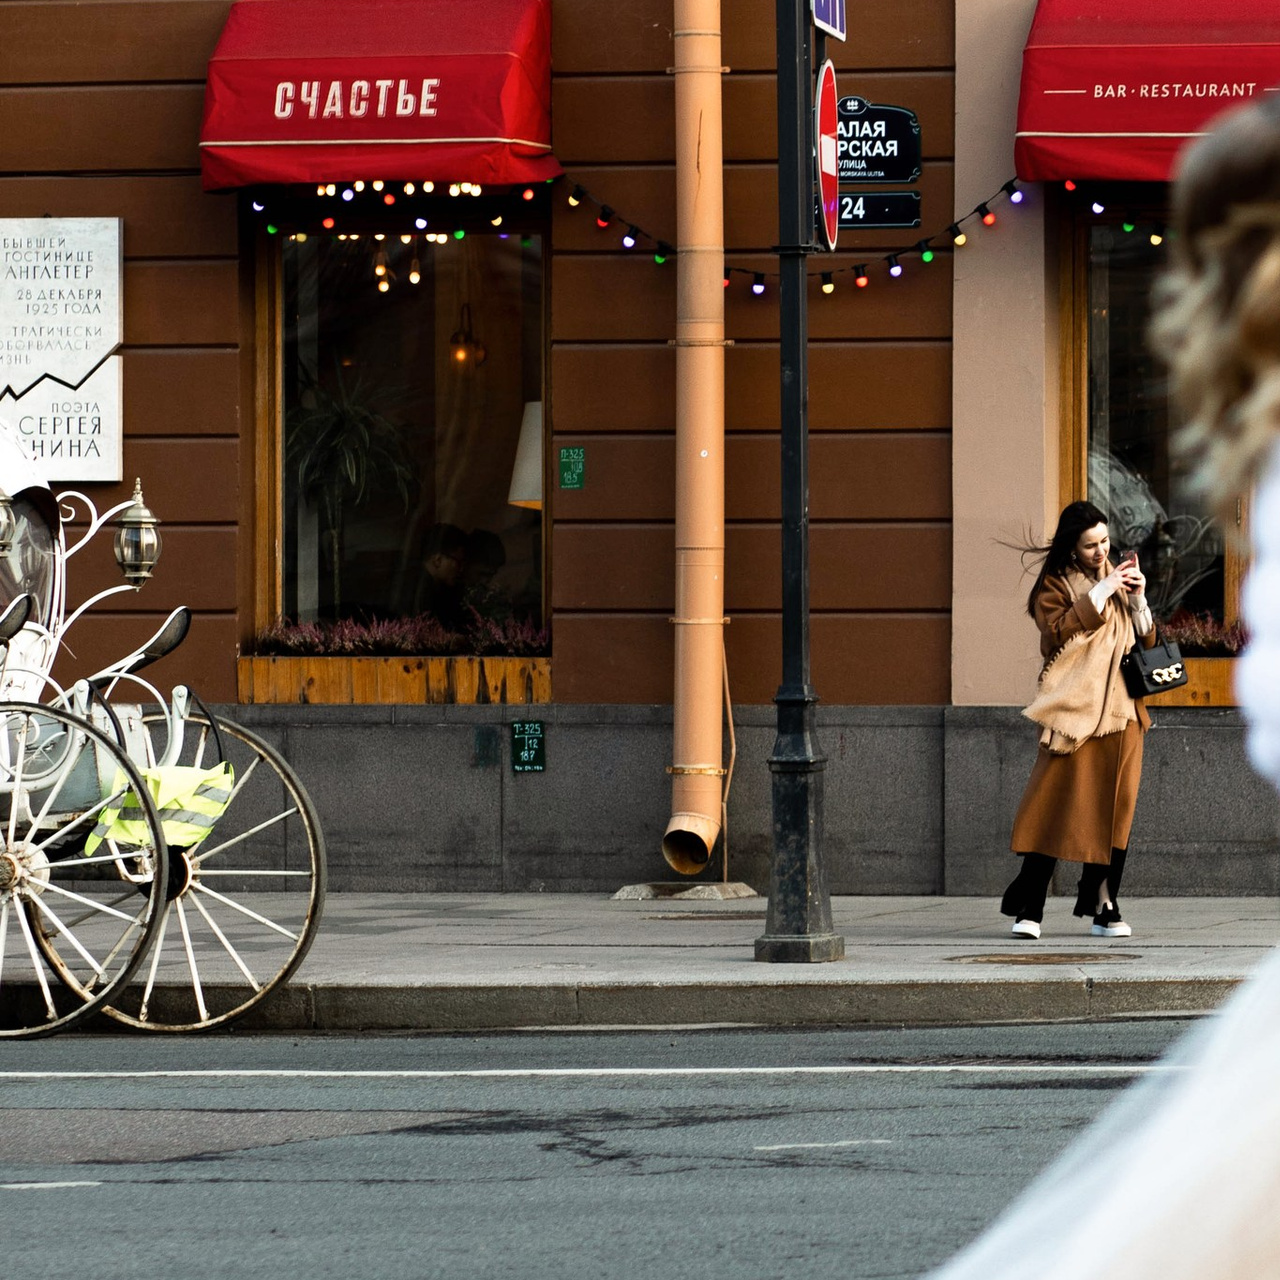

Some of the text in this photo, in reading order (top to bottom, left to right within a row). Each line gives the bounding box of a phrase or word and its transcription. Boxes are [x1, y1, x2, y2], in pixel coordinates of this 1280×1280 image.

[1094, 83, 1256, 98] BAR RESTAURANT
[274, 78, 440, 120] СЧАСТЬЕ
[838, 121, 886, 138] АЛАЯ
[838, 140, 898, 157] РСКАЯ
[838, 160, 867, 170] УЛИЦА
[841, 197, 865, 219] 24
[3, 238, 66, 249] БЫВШЕЙ
[5, 251, 94, 263] ГОСТИНИЦЕ
[5, 266, 94, 280] АНГЛЕТЕР
[17, 289, 102, 300] 28 ДЕКАБРЯ
[26, 304, 101, 315] 1925 ГОДА
[12, 326, 102, 337] ТРАГИЧЕСКИ
[51, 402, 101, 413] ПОЭТА
[19, 416, 102, 435] СЕРГЕЯ
[31, 439, 101, 458] НИНА
